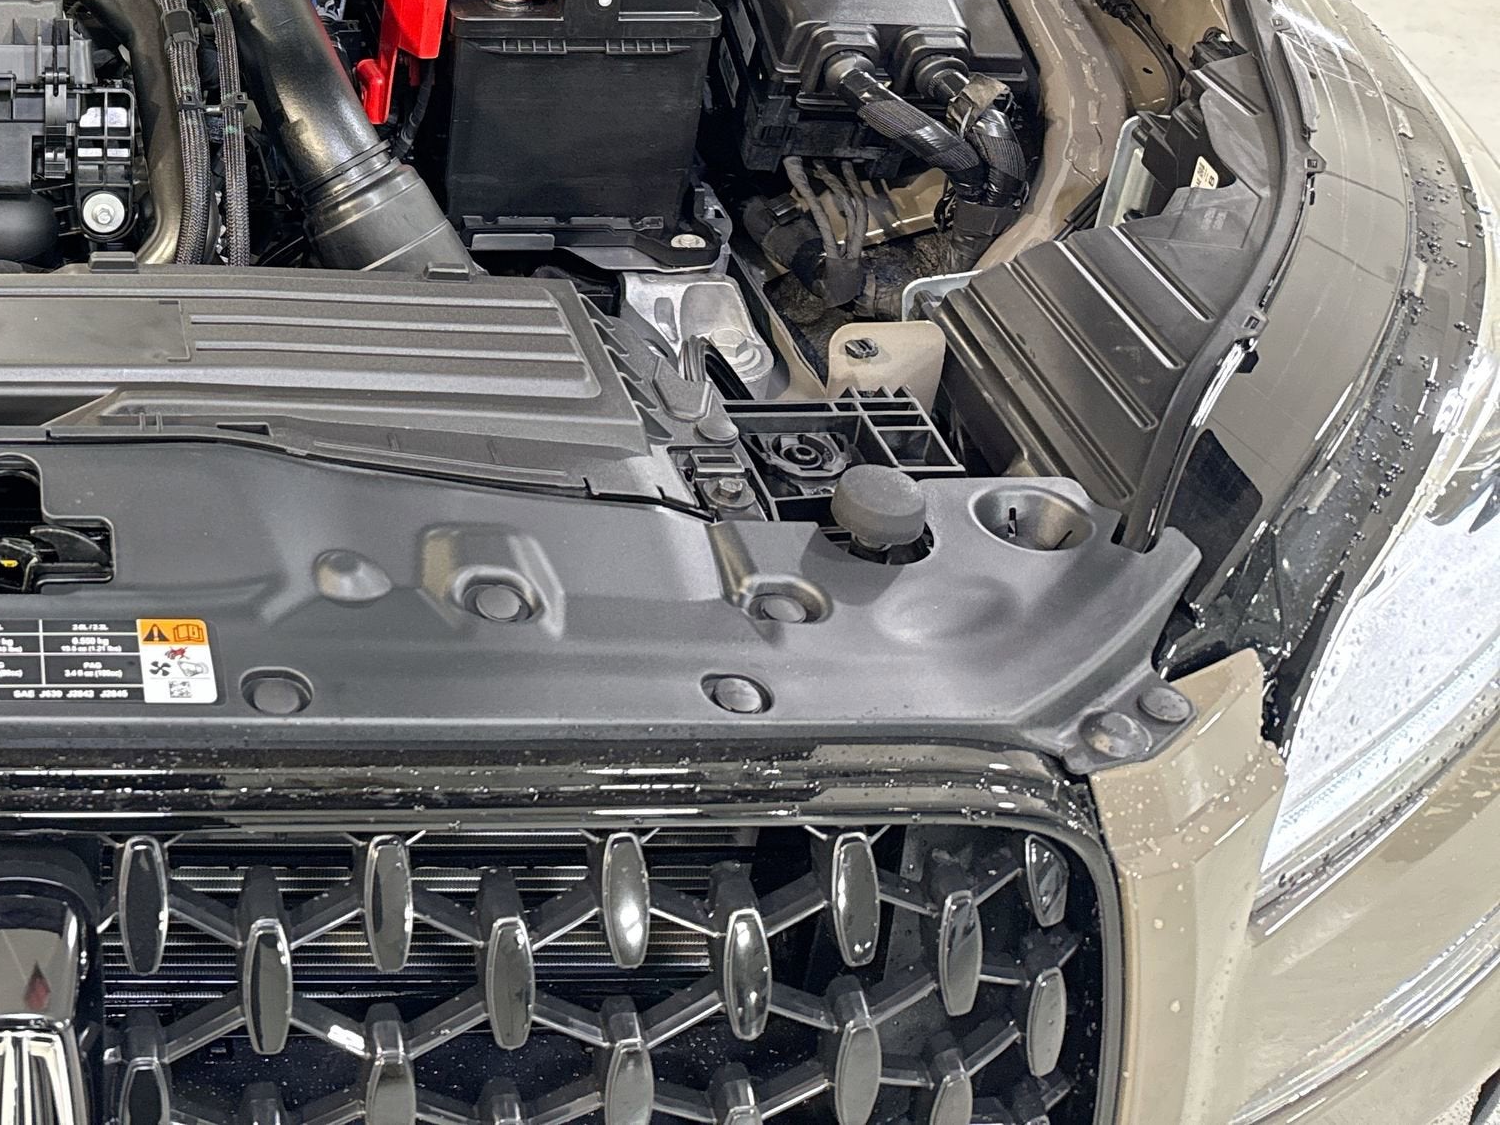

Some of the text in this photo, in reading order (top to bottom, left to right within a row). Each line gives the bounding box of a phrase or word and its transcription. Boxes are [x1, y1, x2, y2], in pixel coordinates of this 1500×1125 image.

[1, 638, 14, 647] kg
[97, 637, 109, 646] kg
[13, 689, 35, 698] SAE
